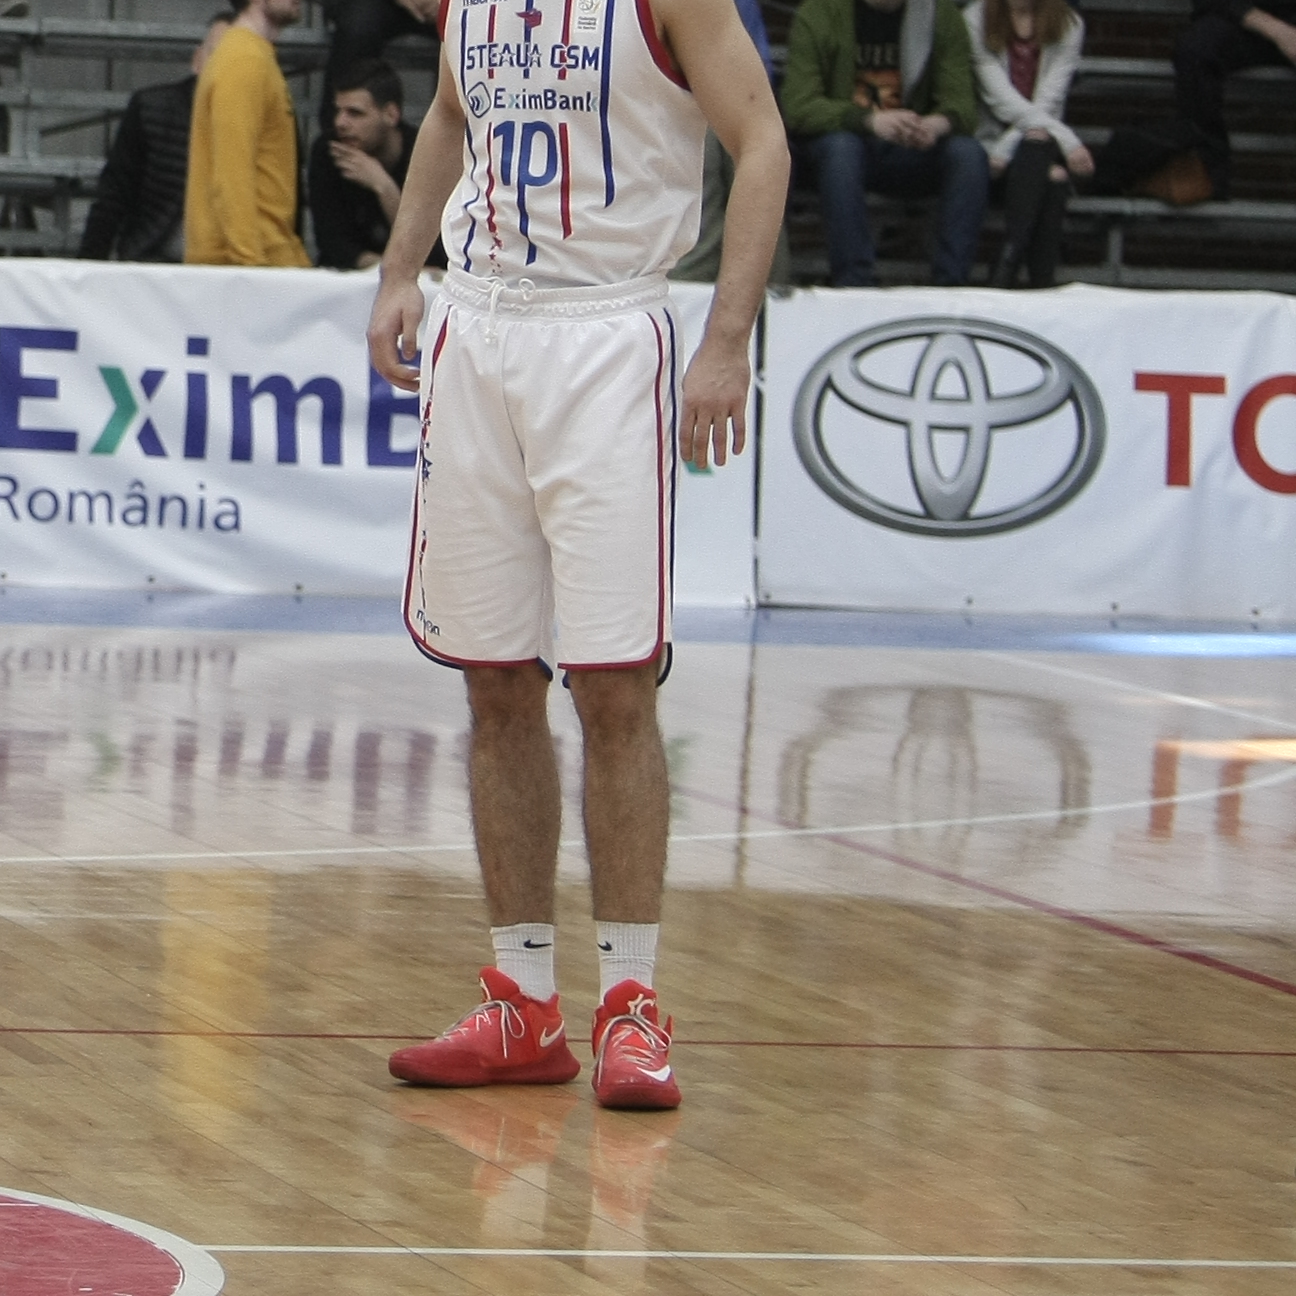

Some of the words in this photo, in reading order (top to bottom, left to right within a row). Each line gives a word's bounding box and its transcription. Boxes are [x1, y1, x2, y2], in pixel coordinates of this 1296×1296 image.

[466, 42, 542, 70] STEAUA
[550, 44, 601, 71] CSM
[493, 87, 599, 113] EximBank
[493, 120, 558, 187] 10
